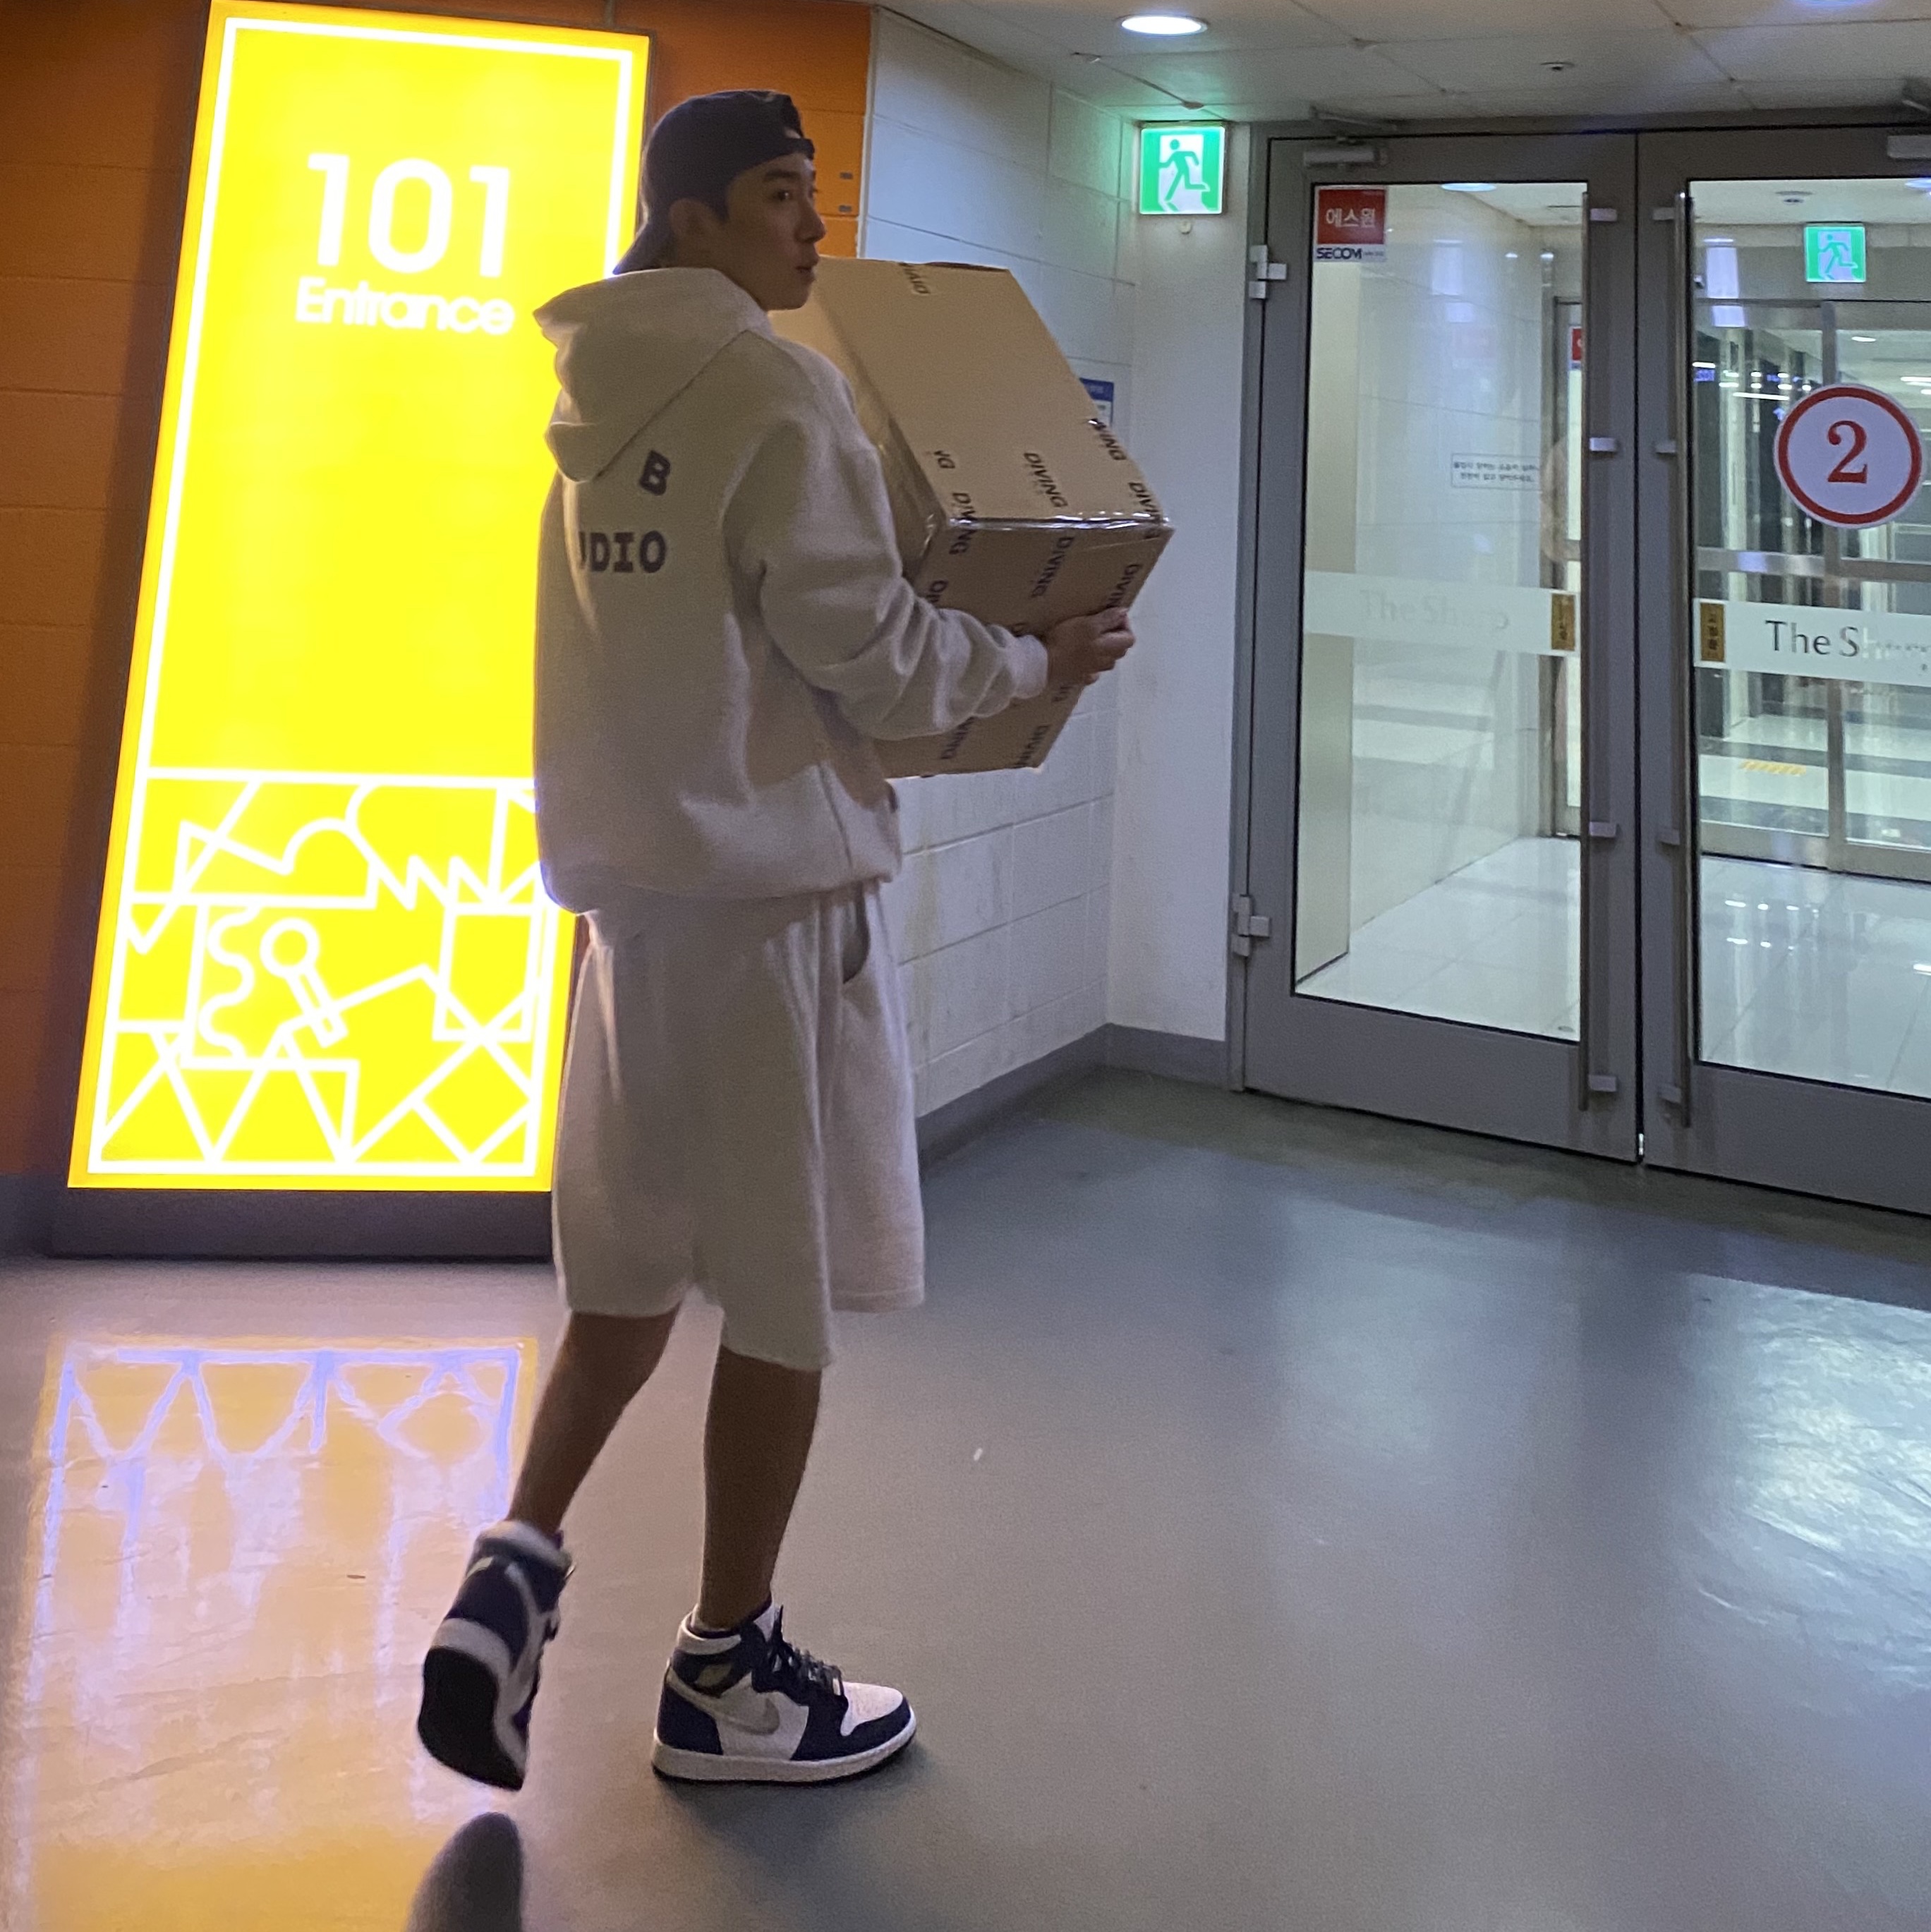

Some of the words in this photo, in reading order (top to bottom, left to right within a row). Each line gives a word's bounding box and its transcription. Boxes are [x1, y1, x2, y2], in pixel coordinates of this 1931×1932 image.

[306, 152, 511, 278] 101
[1326, 207, 1376, 228] 에스원
[1316, 247, 1362, 259] SECOM
[295, 276, 515, 335] Entrance
[639, 449, 671, 496] B
[1827, 420, 1868, 484] 2
[1023, 452, 1069, 508] DIVING
[1030, 536, 1075, 598] DIVING
[1106, 564, 1142, 608] DIVIN
[1764, 620, 1832, 656] The
